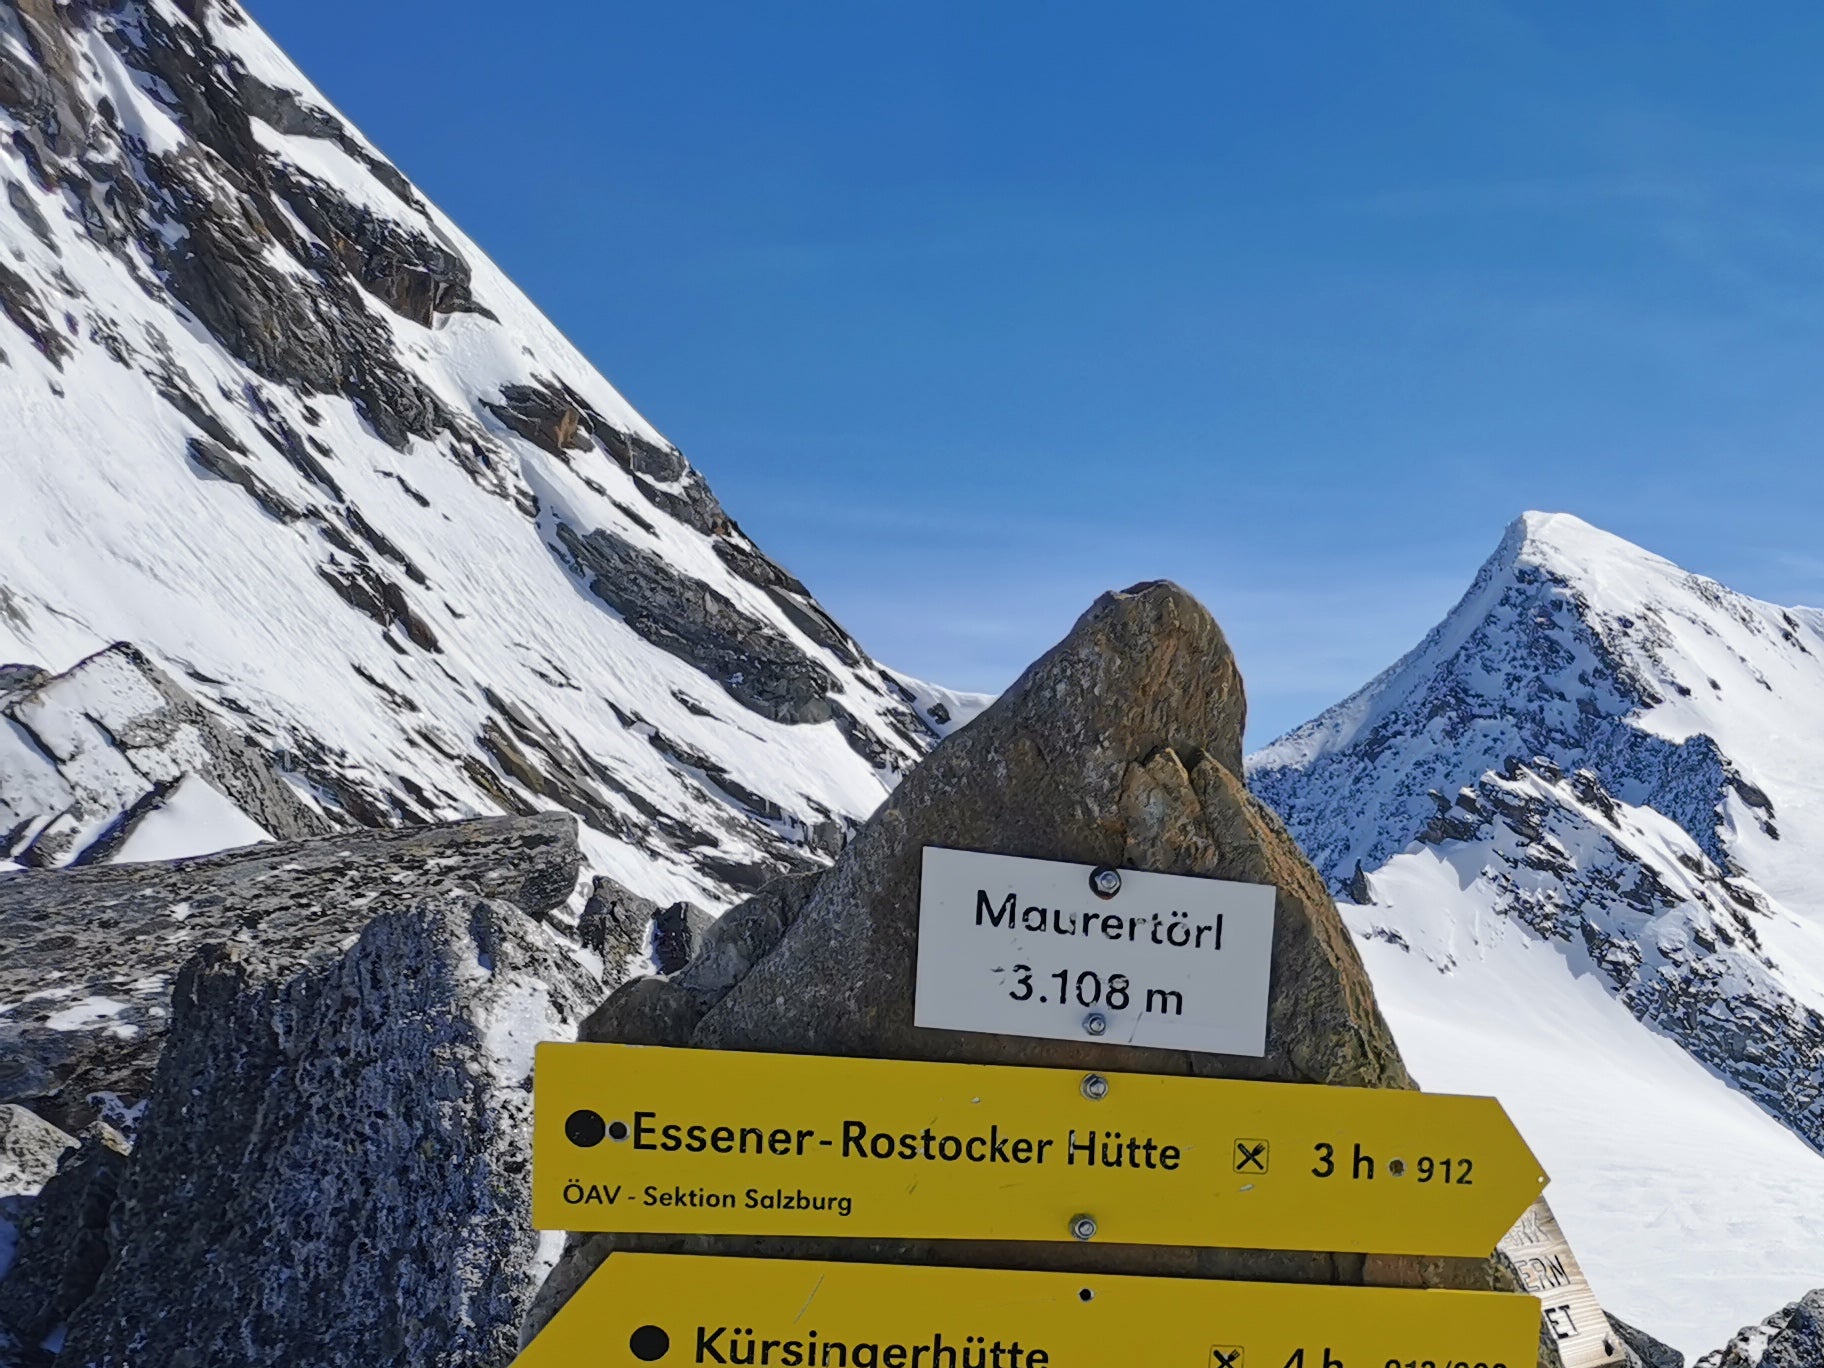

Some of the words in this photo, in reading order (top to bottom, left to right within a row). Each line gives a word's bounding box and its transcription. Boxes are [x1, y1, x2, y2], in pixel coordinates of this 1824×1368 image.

[975, 888, 1224, 951] Maurertörl
[1009, 964, 1130, 1011] 3.108
[1145, 989, 1183, 1016] m
[633, 1111, 1054, 1164] Essener-Rostocker
[1067, 1129, 1181, 1171] Hütte
[1311, 1142, 1335, 1178] 3
[1352, 1143, 1375, 1180] h
[1417, 1156, 1473, 1185] 912
[563, 1178, 622, 1205] ÖAV
[643, 1185, 736, 1208] Sektion
[744, 1188, 852, 1217] Salzburg
